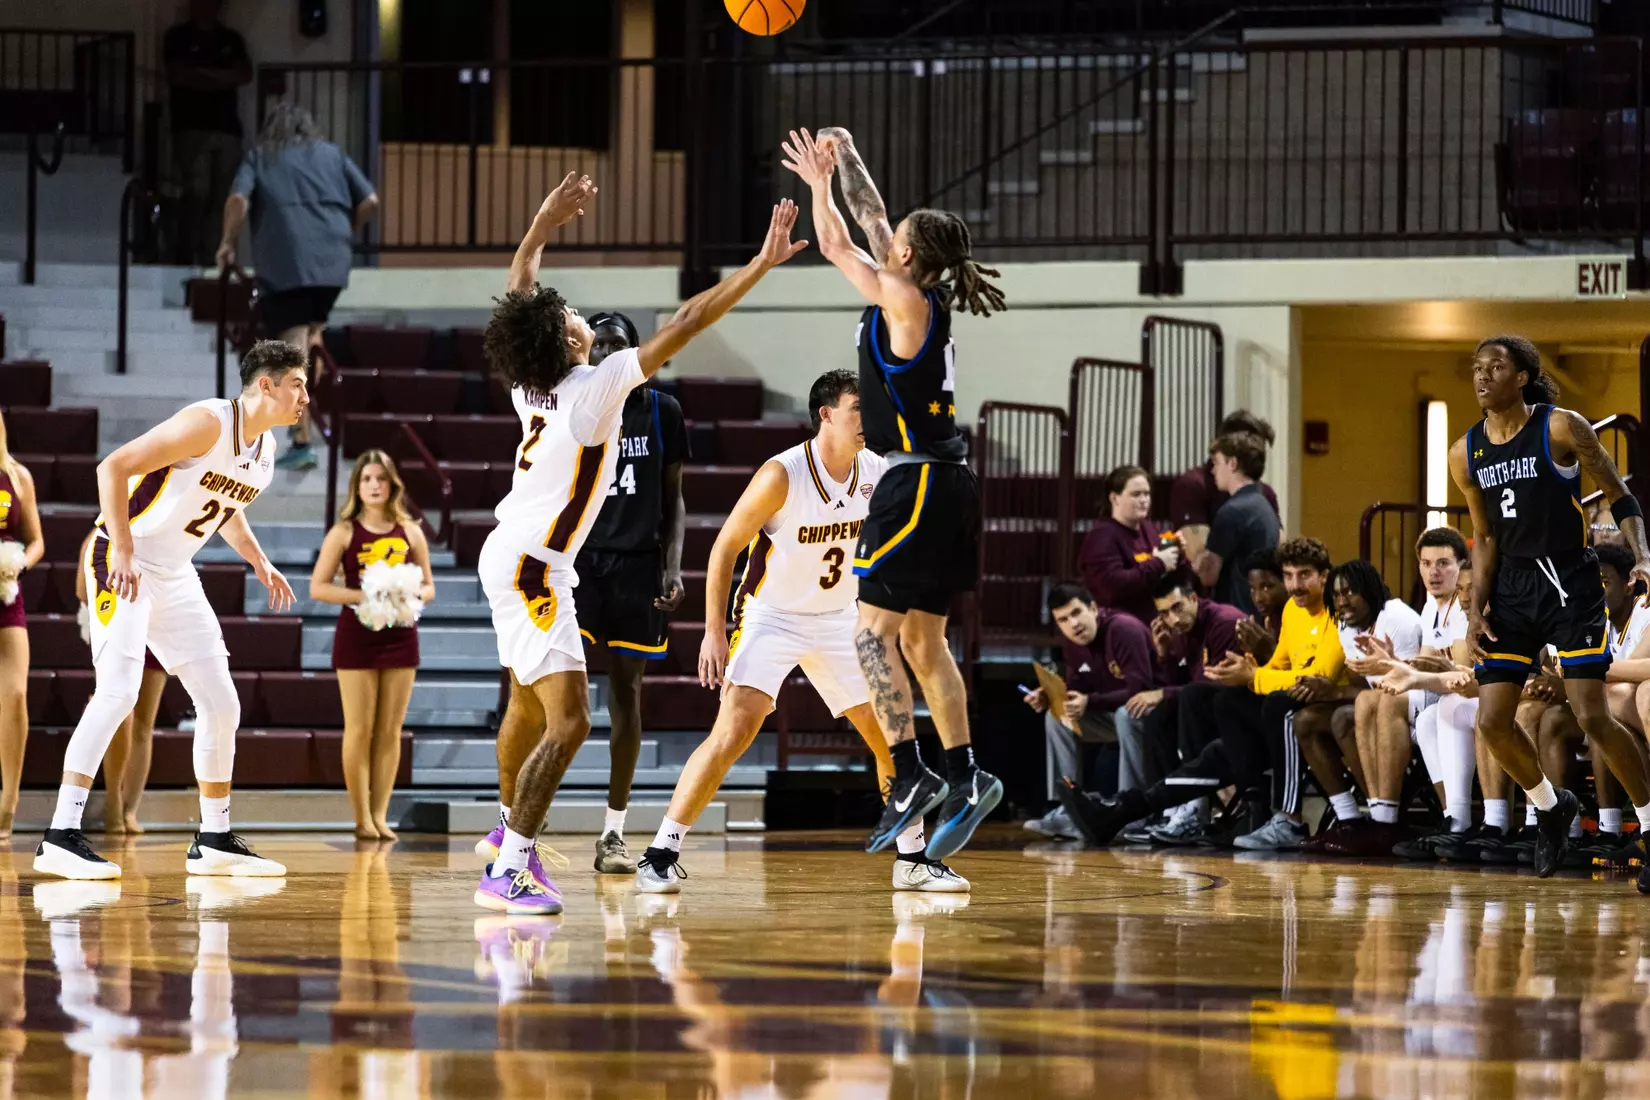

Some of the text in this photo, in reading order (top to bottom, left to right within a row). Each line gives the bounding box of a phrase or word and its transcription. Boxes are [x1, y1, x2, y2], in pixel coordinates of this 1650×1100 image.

[1578, 263, 1621, 295] EXIT
[518, 414, 547, 472] 2
[621, 436, 649, 458] PARK
[1476, 456, 1538, 489] NORTH PARK
[183, 498, 237, 538] 21
[1500, 487, 1517, 518] 2
[819, 546, 845, 590] 3
